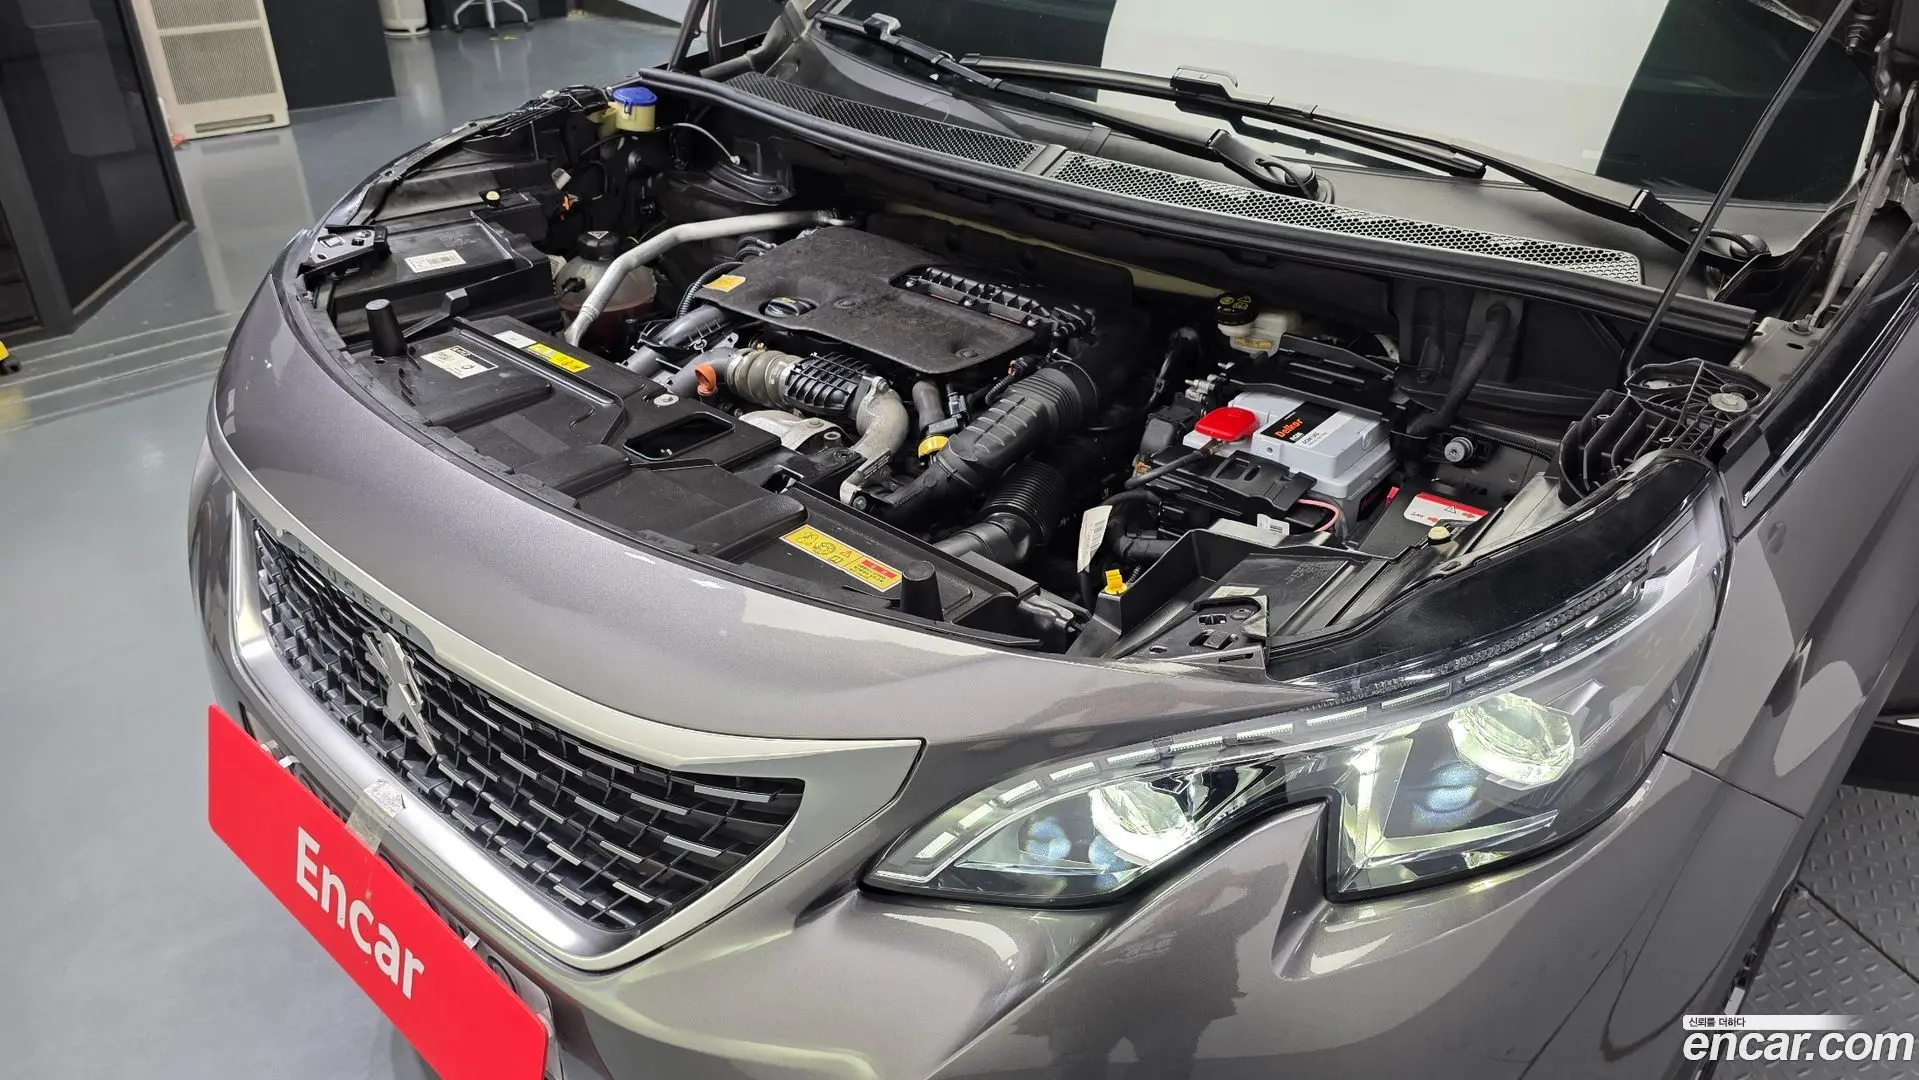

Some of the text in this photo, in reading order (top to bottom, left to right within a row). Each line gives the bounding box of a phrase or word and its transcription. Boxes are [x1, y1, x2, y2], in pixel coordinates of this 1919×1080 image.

[1274, 418, 1304, 438] Delkor
[298, 543, 413, 636] PEUGEOT
[295, 825, 425, 1000] Encar
